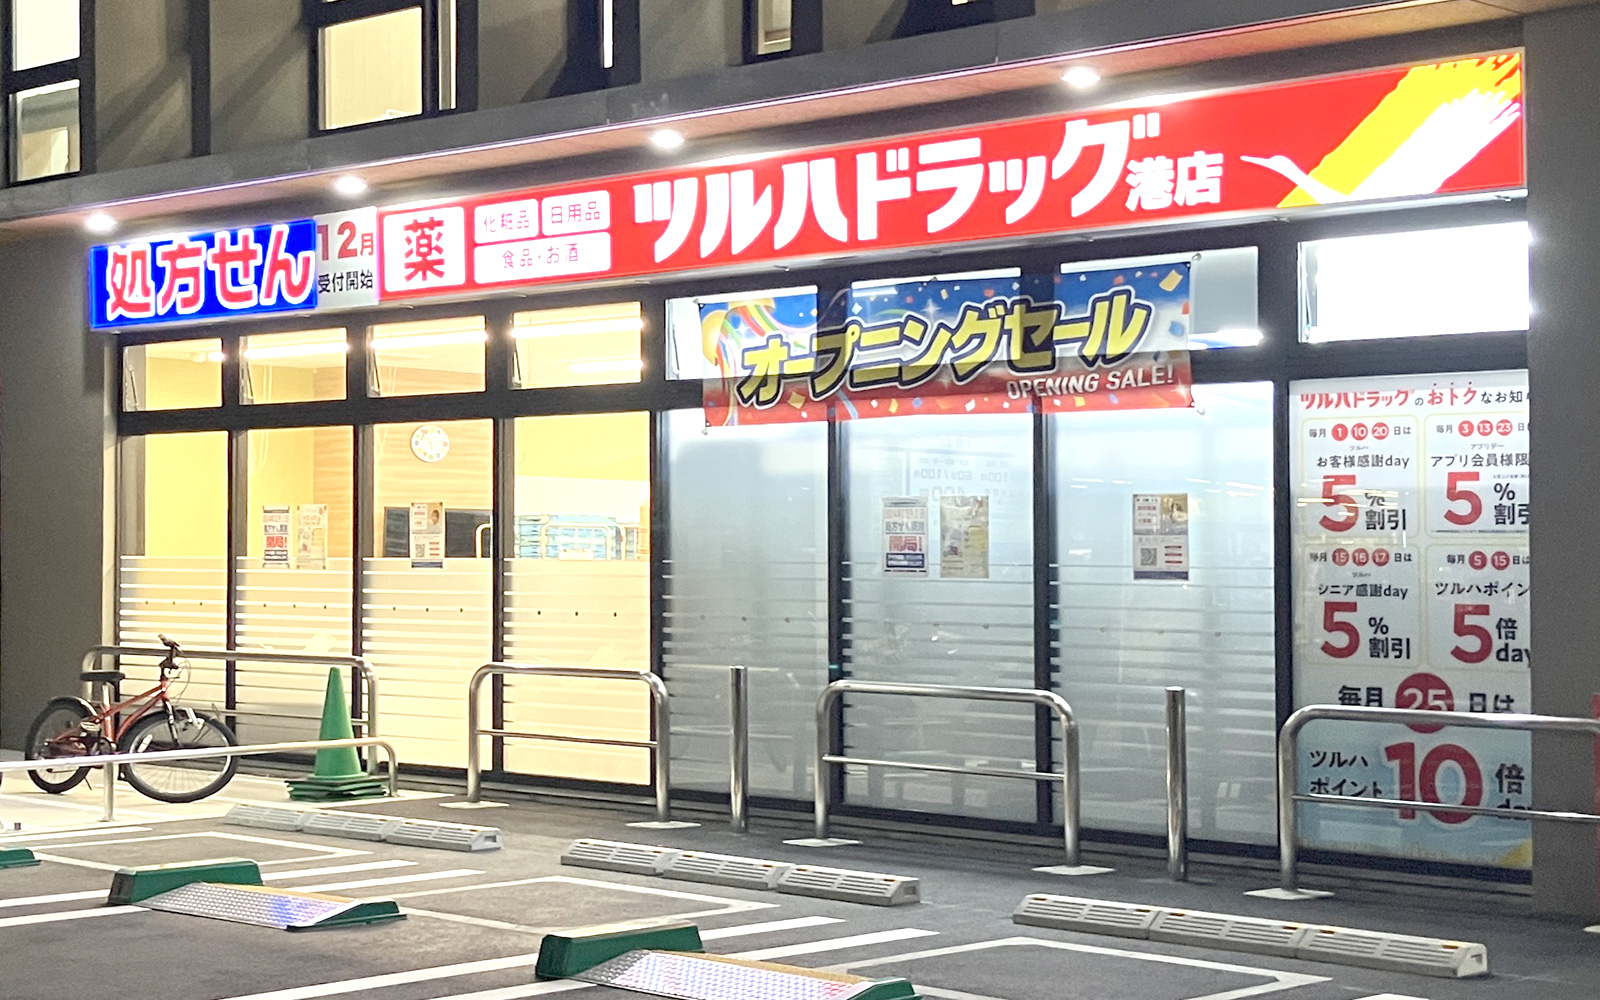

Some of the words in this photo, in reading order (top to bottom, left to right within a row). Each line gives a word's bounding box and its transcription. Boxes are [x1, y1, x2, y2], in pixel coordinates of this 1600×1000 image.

[633, 113, 1161, 263] ツルハドラッグ
[1125, 151, 1223, 212] 港店
[483, 209, 530, 233] 化粧品
[551, 201, 600, 225] 日用品
[317, 220, 374, 261] 12月
[403, 216, 445, 282] 薬
[502, 242, 579, 269] 食品・お酒
[106, 224, 315, 320] 処方せん
[317, 270, 374, 294] 受付開始
[736, 285, 1154, 408] オープニングセール
[1007, 375, 1099, 400] OPENING
[1105, 364, 1174, 389] SALE!
[1301, 387, 1530, 409] ツルハドラッグのおトクなお知
[1309, 428, 1326, 438] 毎月
[1394, 426, 1411, 435] 日は
[1436, 424, 1453, 433] 毎月
[1518, 422, 1530, 432] 日
[1317, 454, 1410, 469] お客様感謝day
[1318, 474, 1359, 532] 5
[1365, 509, 1406, 531] 割引
[1443, 471, 1482, 526] 5
[1494, 483, 1515, 501] %
[1394, 553, 1412, 562] 日は
[1447, 554, 1465, 564] 毎月
[1318, 584, 1408, 600] シニア感謝day
[1321, 601, 1360, 658] 5
[1368, 617, 1389, 634] %
[1450, 603, 1493, 664] 5
[1496, 617, 1518, 640] 倍
[1369, 637, 1411, 659] 割引
[1338, 685, 1383, 707] 毎月
[1402, 687, 1448, 711] 25
[1469, 692, 1515, 713] 日は
[1310, 750, 1369, 768] ツルハ
[1310, 777, 1383, 798] ポイント
[1384, 741, 1483, 825] 10
[1495, 763, 1525, 794] 倍
